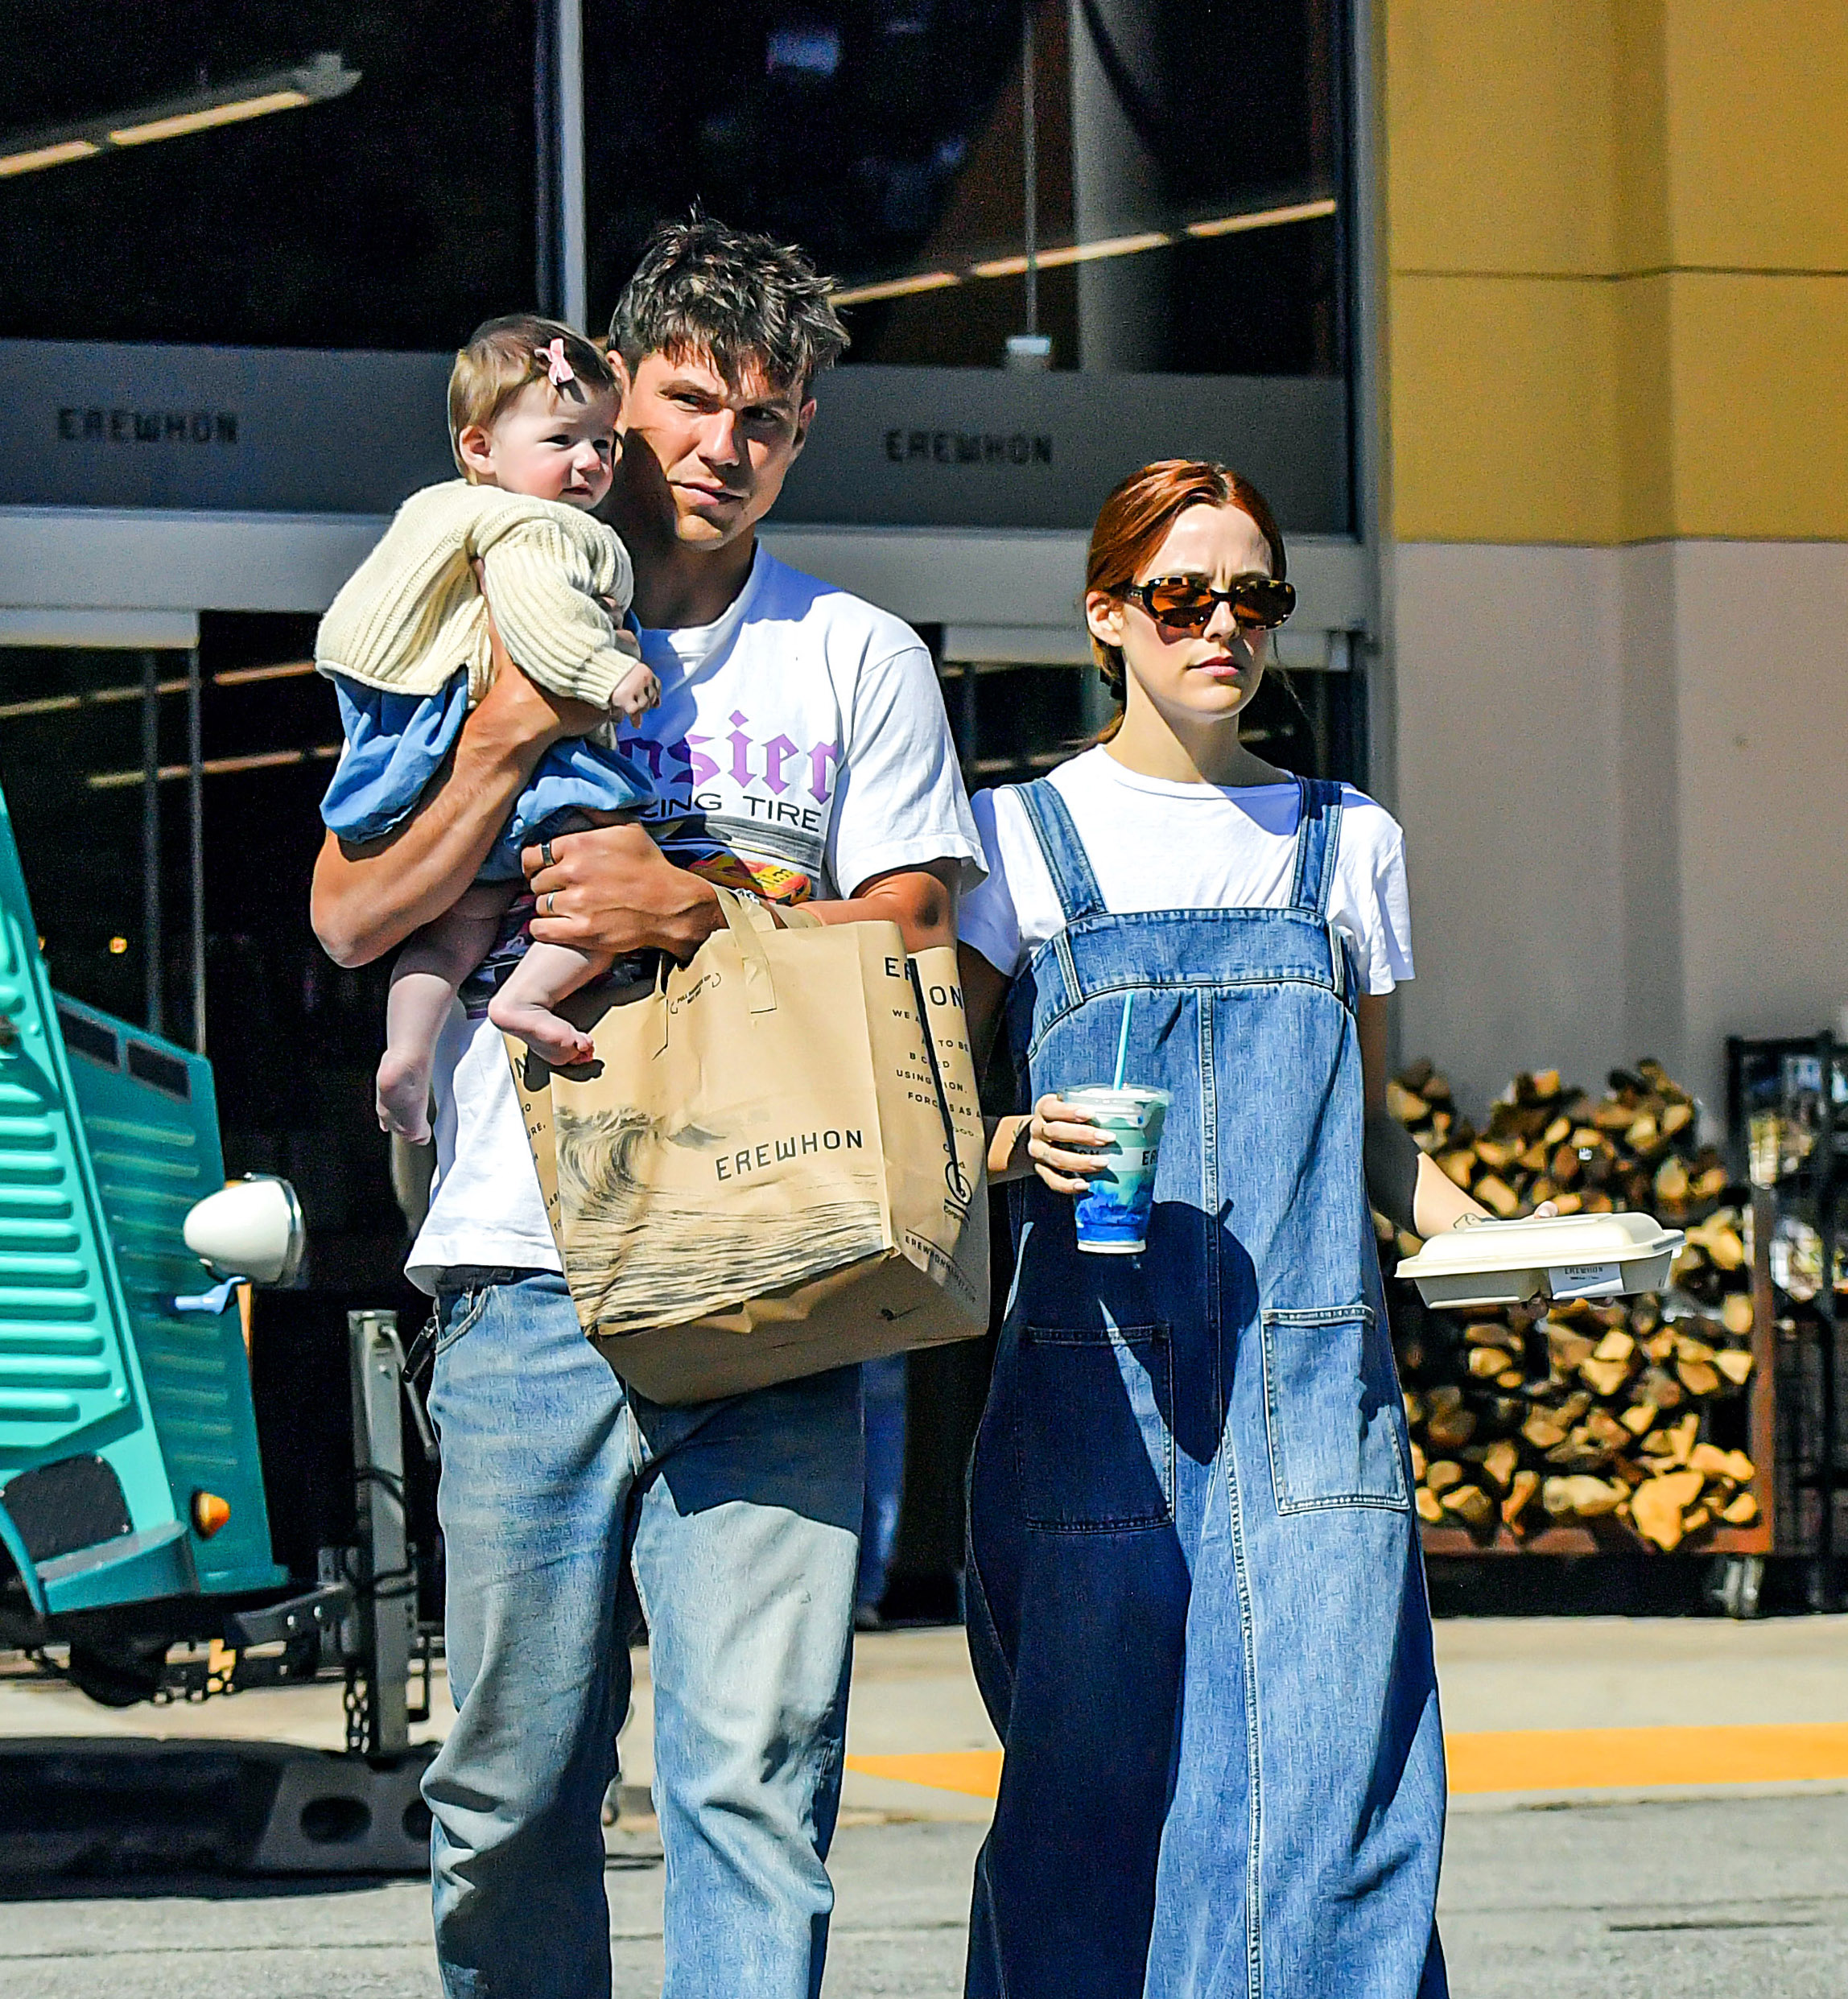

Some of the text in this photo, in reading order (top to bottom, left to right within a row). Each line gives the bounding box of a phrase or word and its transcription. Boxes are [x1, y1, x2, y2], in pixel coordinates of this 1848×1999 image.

[57, 407, 238, 444] EREWHON
[885, 429, 1053, 464] EREWHON
[742, 795, 822, 833] TIRE
[892, 1008, 910, 1020] WE
[938, 1039, 954, 1048] TO
[896, 1069, 933, 1086] USING
[716, 1129, 864, 1181] EREWHON
